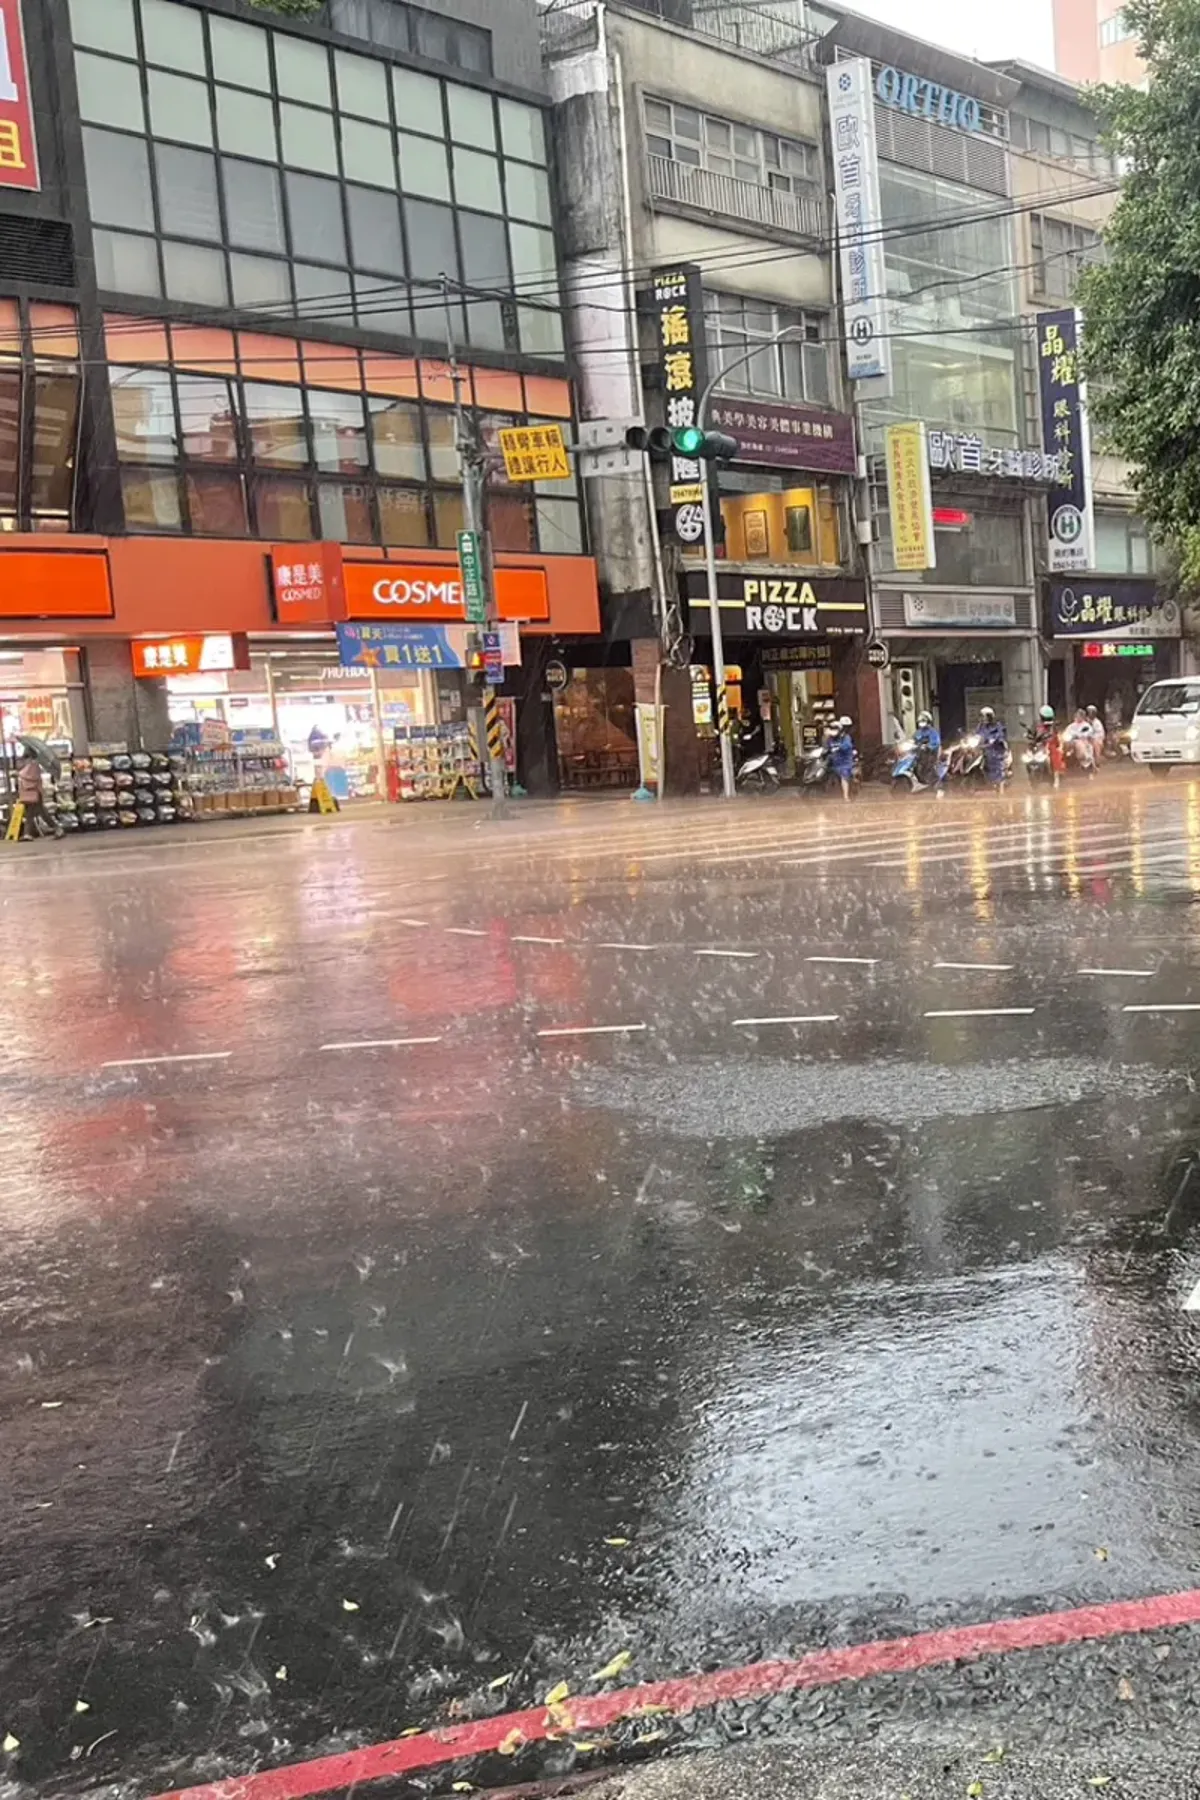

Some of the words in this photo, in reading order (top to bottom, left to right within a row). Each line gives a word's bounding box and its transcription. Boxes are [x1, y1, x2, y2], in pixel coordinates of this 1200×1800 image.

[876, 66, 980, 131] ORTHO
[655, 285, 687, 301] ROCK
[275, 562, 323, 586] 康是美
[281, 587, 322, 602] COSMED
[373, 579, 465, 605] COSME
[744, 579, 817, 604] PIZZA
[746, 604, 818, 632] ROCK
[383, 644, 443, 665] 買1送1
